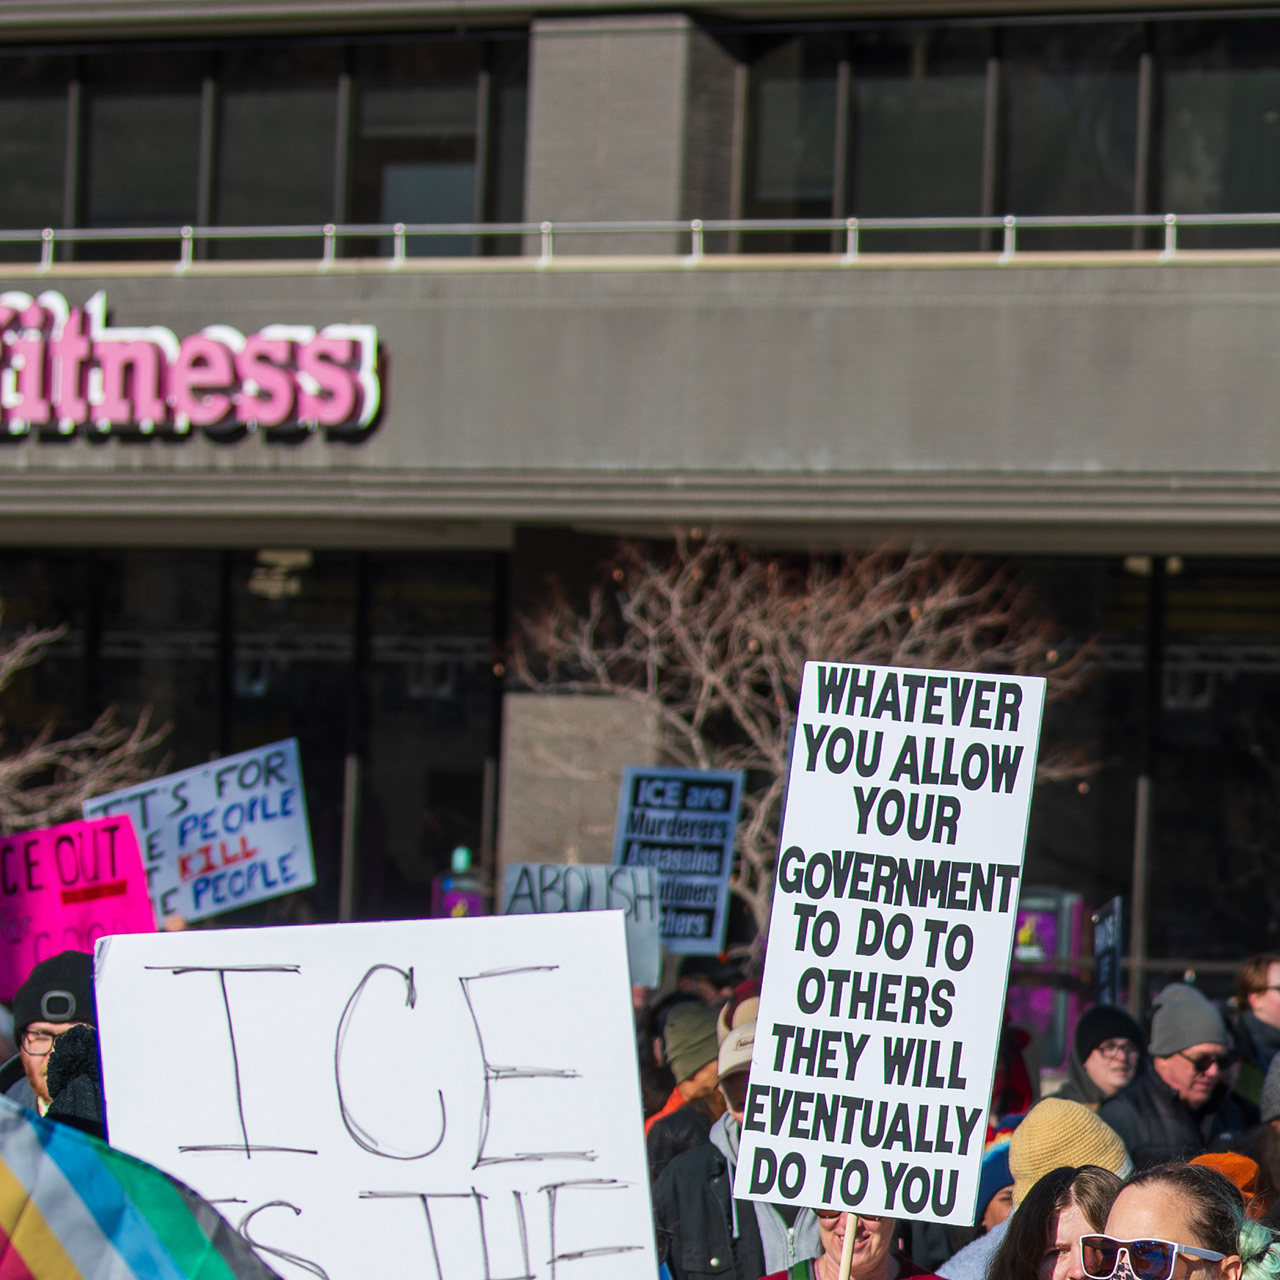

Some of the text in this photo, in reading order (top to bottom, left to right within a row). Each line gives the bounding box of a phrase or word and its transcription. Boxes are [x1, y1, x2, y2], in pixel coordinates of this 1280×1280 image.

[816, 664, 1024, 733] WHATEVER
[802, 722, 1025, 795] YOU ALLOW
[627, 811, 729, 841] Murderers
[638, 778, 729, 809] ICE are
[852, 785, 962, 846] YOUR
[0, 839, 43, 895] CE
[55, 824, 120, 886] OUT
[507, 866, 656, 922] ABOLISH
[777, 844, 1021, 914] GOVERNMENT
[793, 902, 975, 972] TO DO TO
[796, 966, 957, 1029] OTHERS
[143, 960, 600, 1171] ICE
[771, 1022, 968, 1090] THEY WILL
[744, 1083, 984, 1157] EVENTUALLY
[748, 1146, 960, 1218] DO TO YOU
